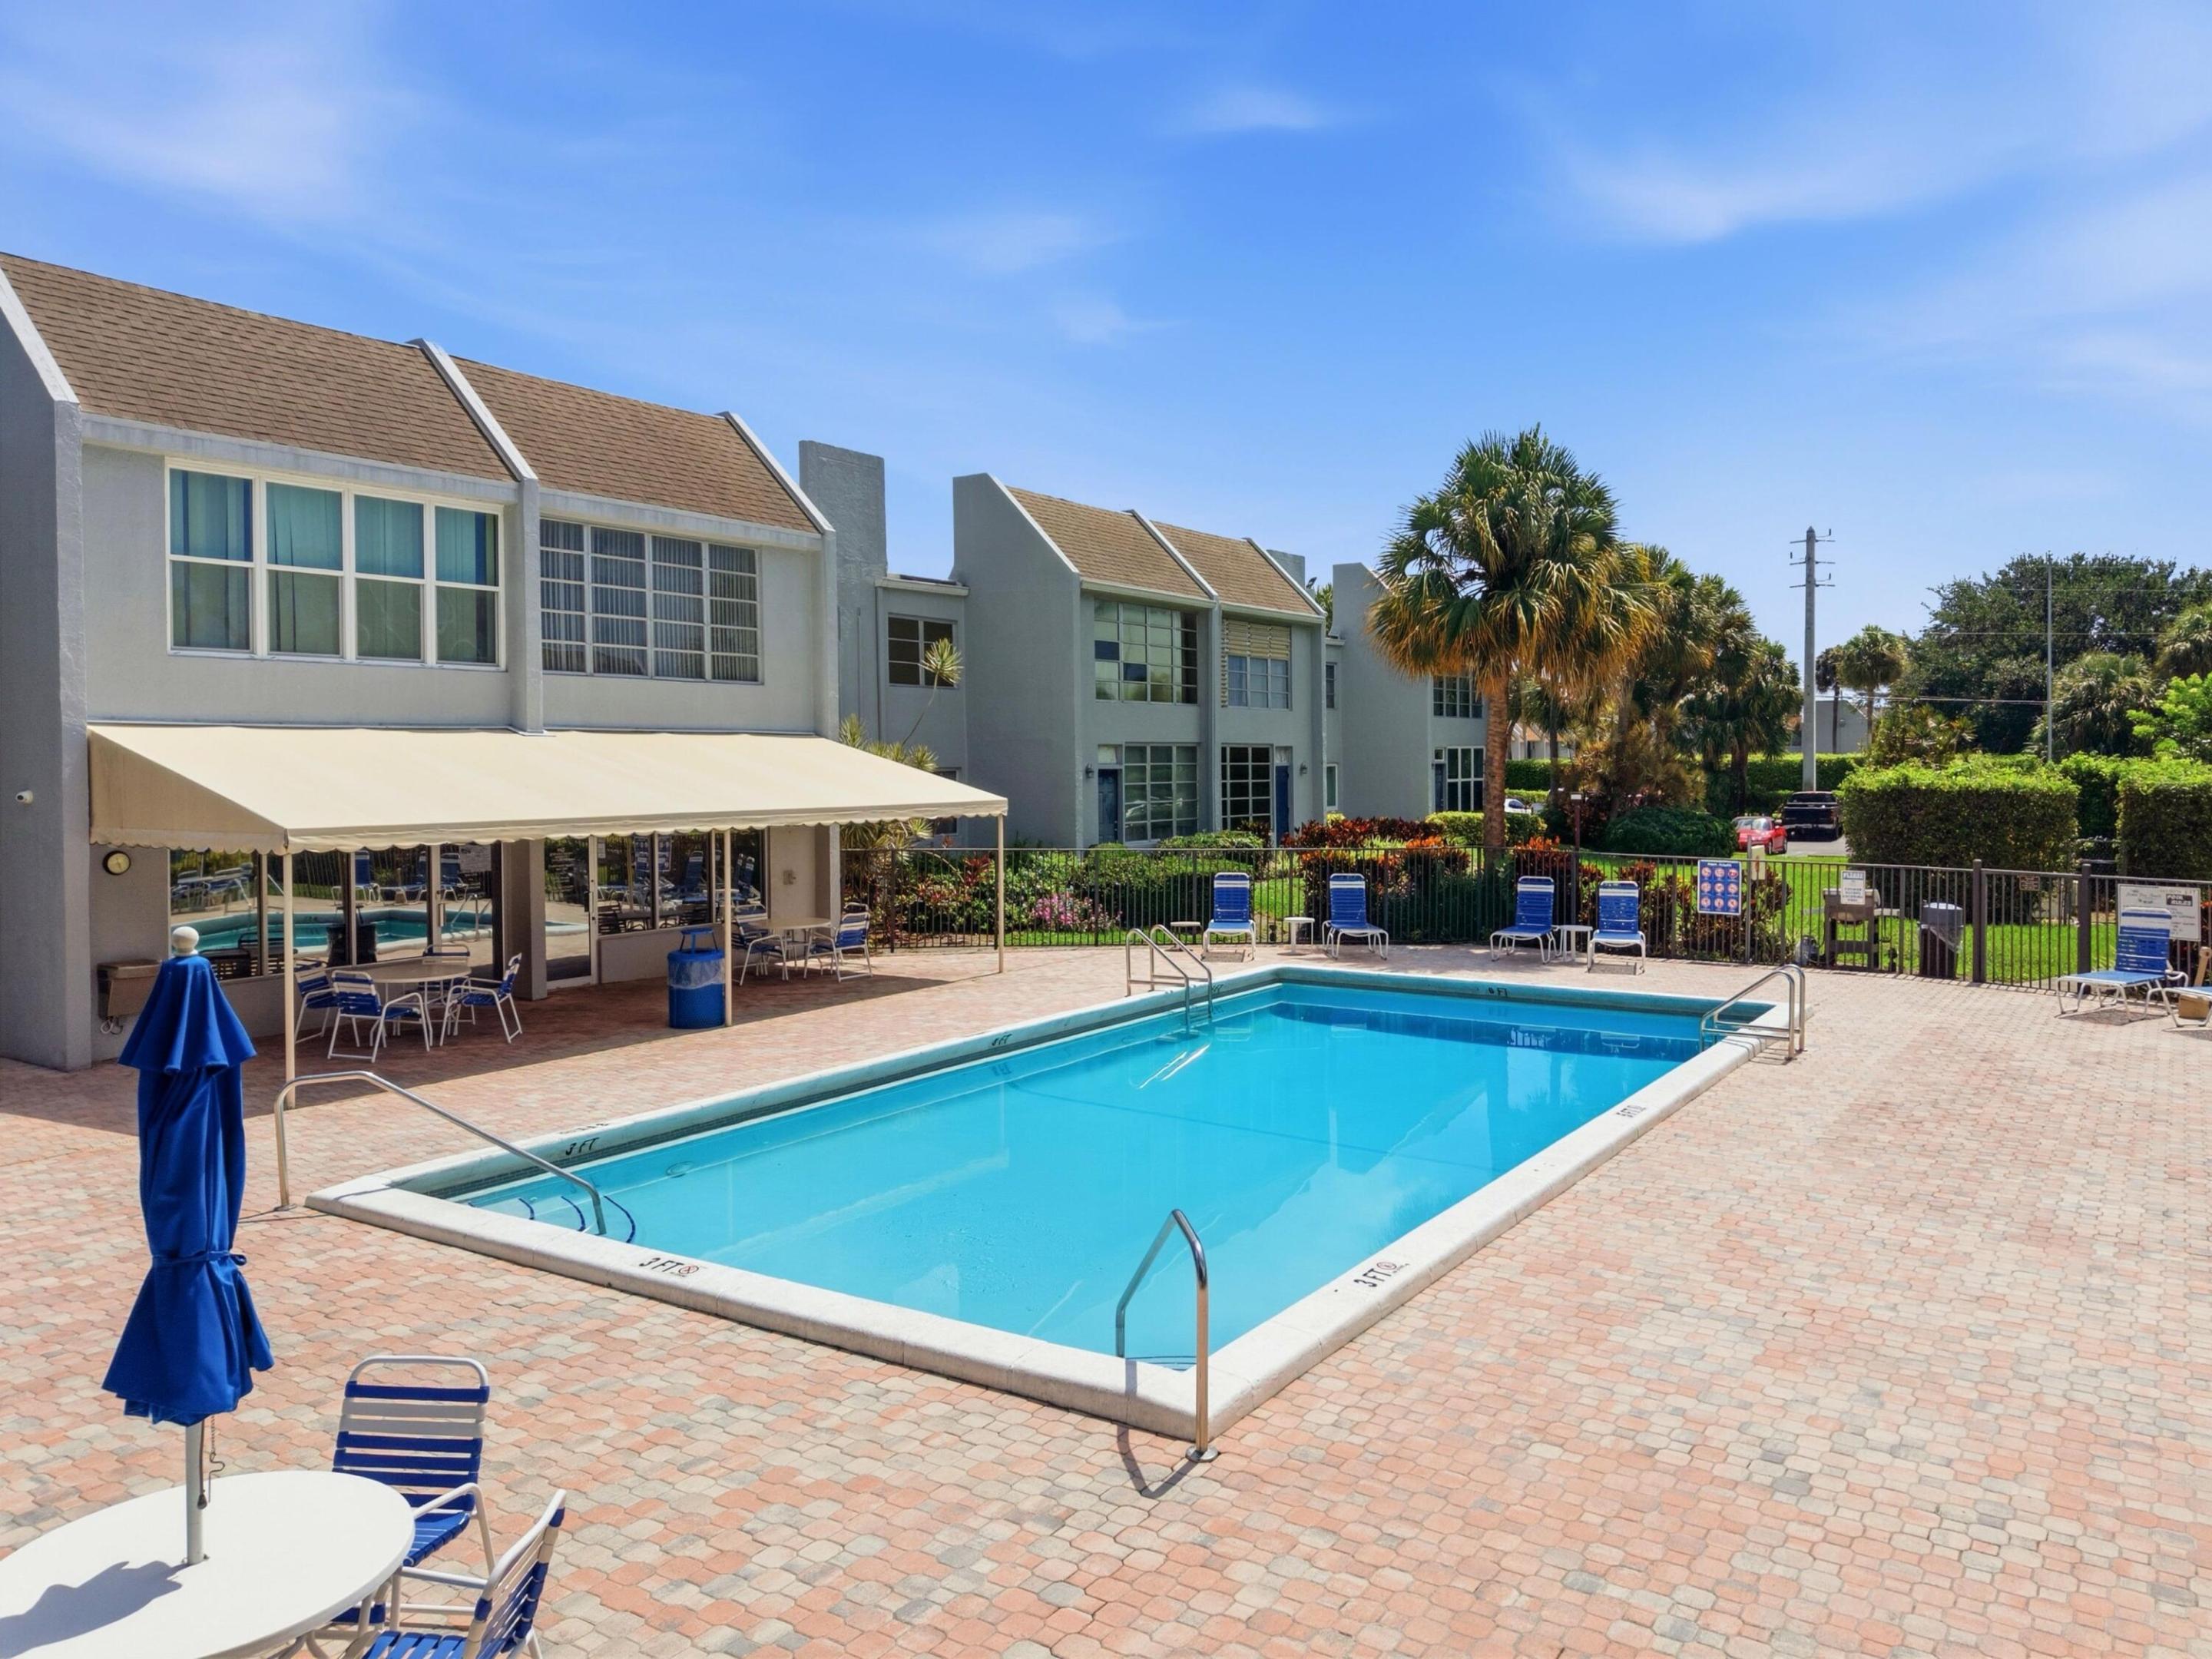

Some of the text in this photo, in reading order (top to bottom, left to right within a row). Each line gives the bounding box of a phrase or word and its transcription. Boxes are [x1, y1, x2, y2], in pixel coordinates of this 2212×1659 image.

[1497, 988, 1508, 998] FT
[998, 1034, 1012, 1045] FT
[565, 1137, 600, 1155] 3 FT
[639, 1257, 684, 1272] 3 FT
[1363, 1268, 1392, 1282] FT
[1353, 1279, 1377, 1287] 3
